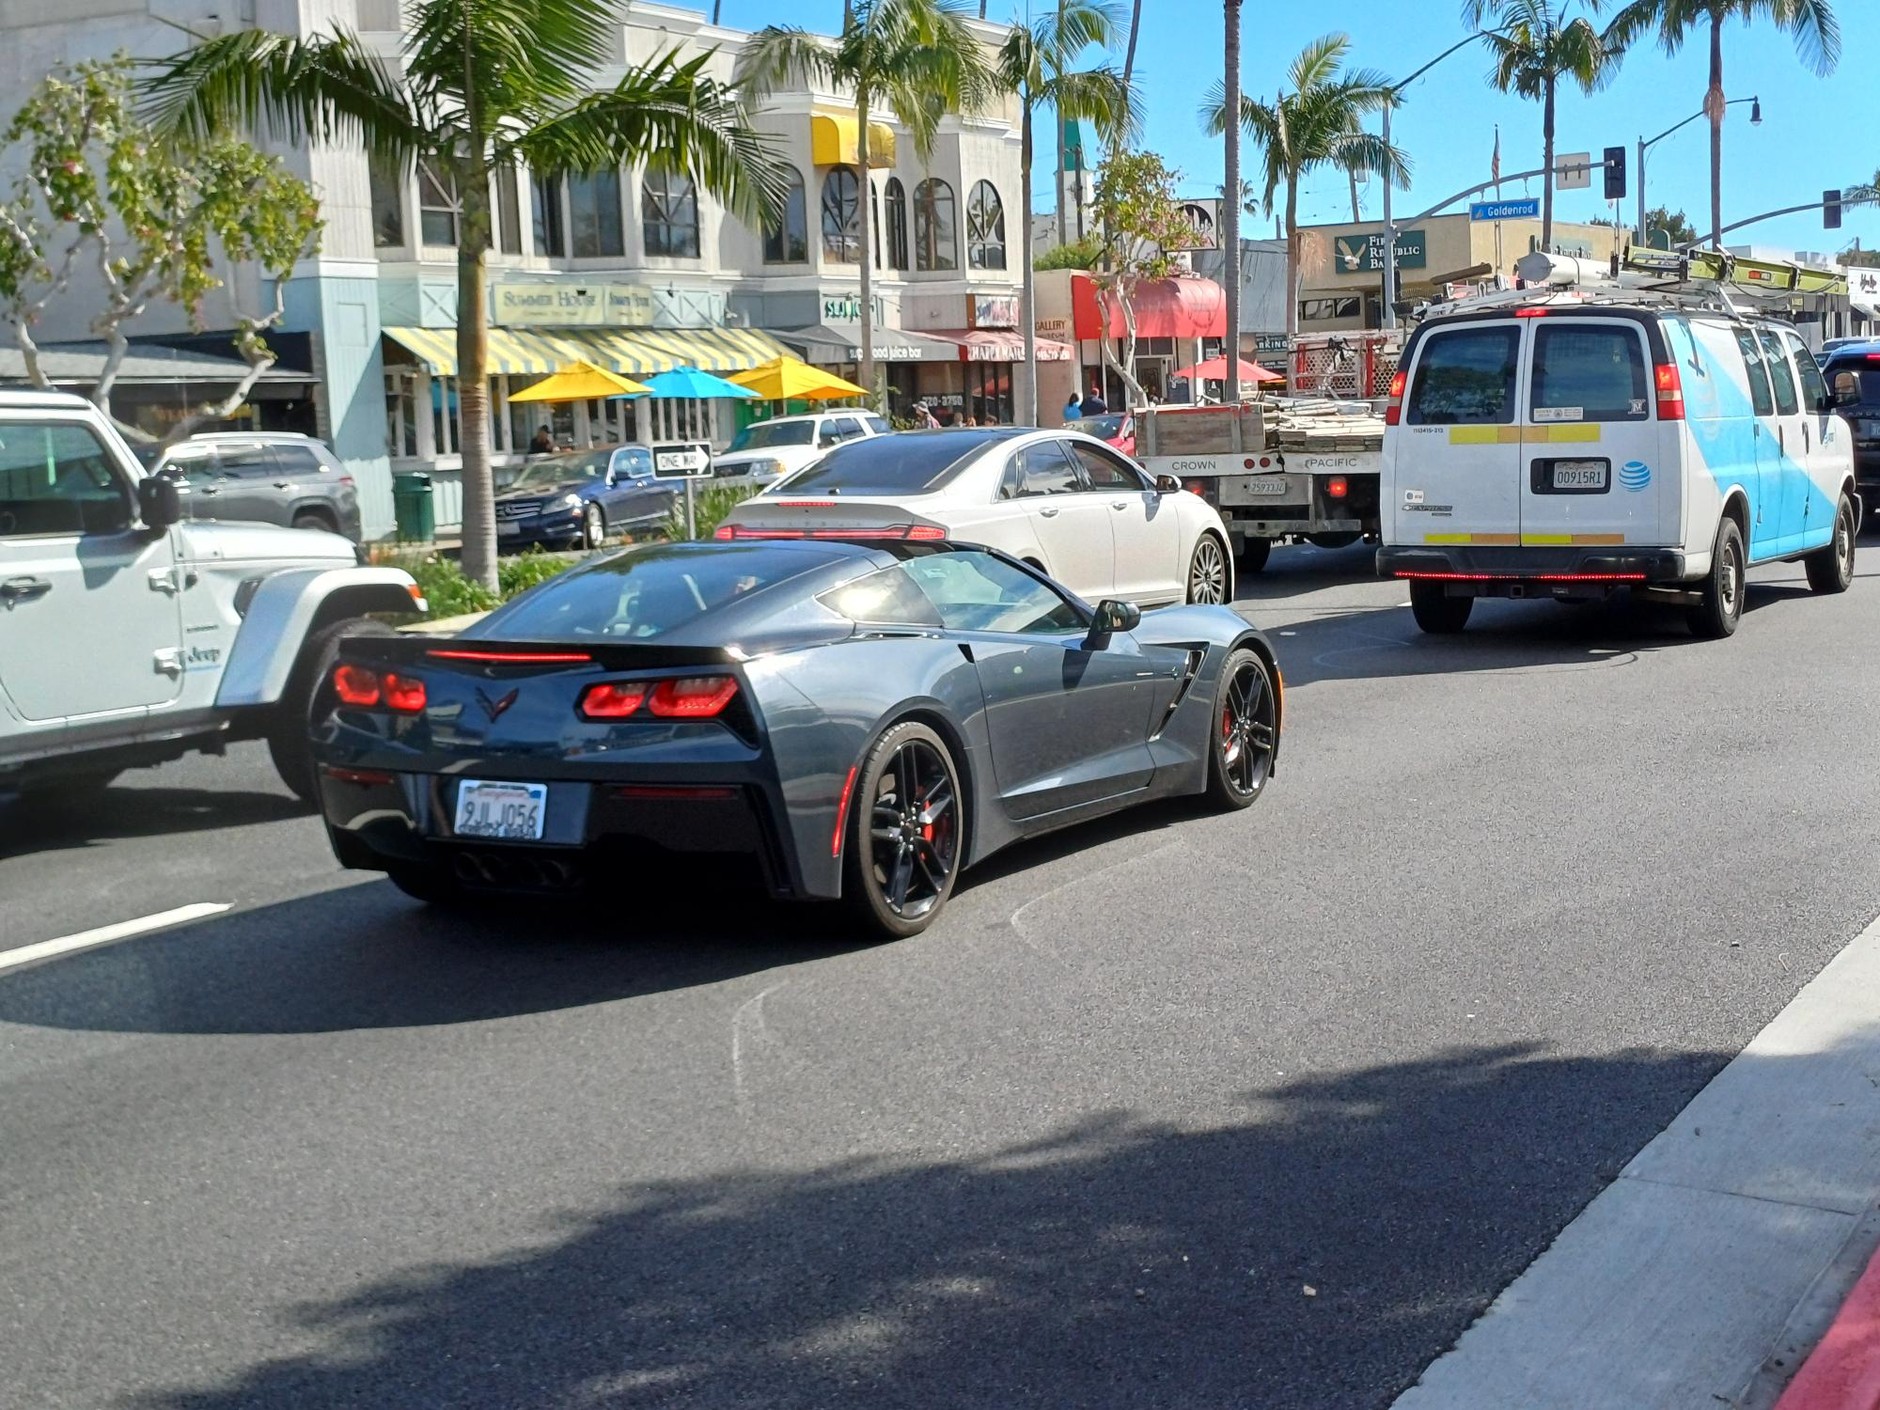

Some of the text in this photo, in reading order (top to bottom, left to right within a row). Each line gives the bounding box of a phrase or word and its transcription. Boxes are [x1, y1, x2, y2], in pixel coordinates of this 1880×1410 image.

[1487, 203, 1534, 217] Goldenrod
[1370, 259, 1399, 269] BAK
[1035, 320, 1065, 331] GALLERY
[660, 454, 680, 468] ONE
[1172, 457, 1358, 471] CROWN PACIFIC
[1557, 471, 1602, 484] 00915R1
